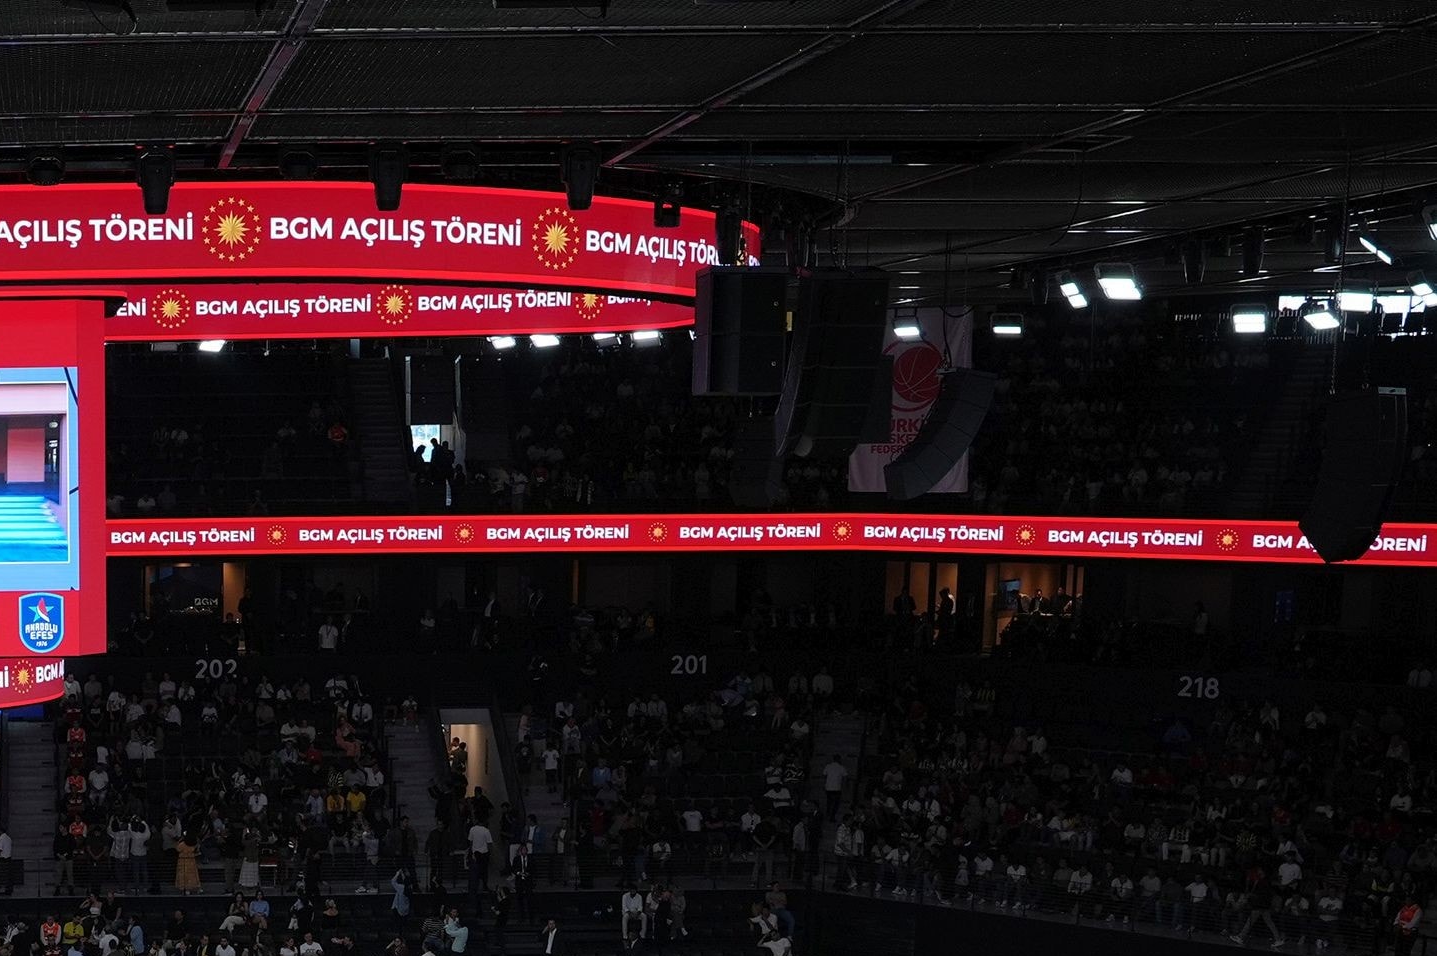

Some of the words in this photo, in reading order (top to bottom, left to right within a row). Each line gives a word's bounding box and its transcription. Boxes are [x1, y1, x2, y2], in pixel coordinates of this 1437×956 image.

[88, 211, 193, 242] TÖRENİ
[270, 216, 333, 240] BGM
[340, 217, 426, 249] AÇILIŞ
[430, 215, 522, 247] TÖRENİ
[585, 229, 631, 255] BGM
[634, 235, 687, 267] AÇILIŞ
[195, 300, 238, 316] BGM
[241, 299, 301, 319] AÇILIŞ
[303, 293, 372, 314] TÖRENİ
[417, 295, 457, 311] BGM
[460, 293, 513, 314] AÇILIŞ
[110, 531, 146, 544] BGM
[148, 530, 197, 546] AÇILIŞ
[198, 527, 255, 543] TÖRENİ
[298, 529, 334, 542] BGM
[336, 528, 385, 544] AÇILIŞ
[386, 525, 443, 541] TÖRENİ
[486, 527, 521, 540] BGM
[523, 527, 572, 543] AÇILIŞ
[573, 523, 629, 539] TÖRENİ
[679, 526, 714, 539] BGM
[716, 526, 764, 542] AÇILIŞ
[766, 522, 821, 538] TÖRENİ
[864, 525, 898, 539] BGM
[899, 526, 946, 543] AÇILIŞ
[948, 525, 1004, 541] TÖRENİ
[1048, 529, 1084, 543] BGM
[1086, 530, 1139, 548] AÇILIŞ
[1141, 529, 1203, 547] TÖRENİ
[1252, 534, 1293, 549] BGM
[25, 622, 59, 634] ANADOLU
[30, 631, 54, 640] EFES
[35, 664, 59, 684] BGM
[195, 658, 239, 680] 202
[670, 654, 708, 676] 201
[1177, 675, 1220, 700] 218
